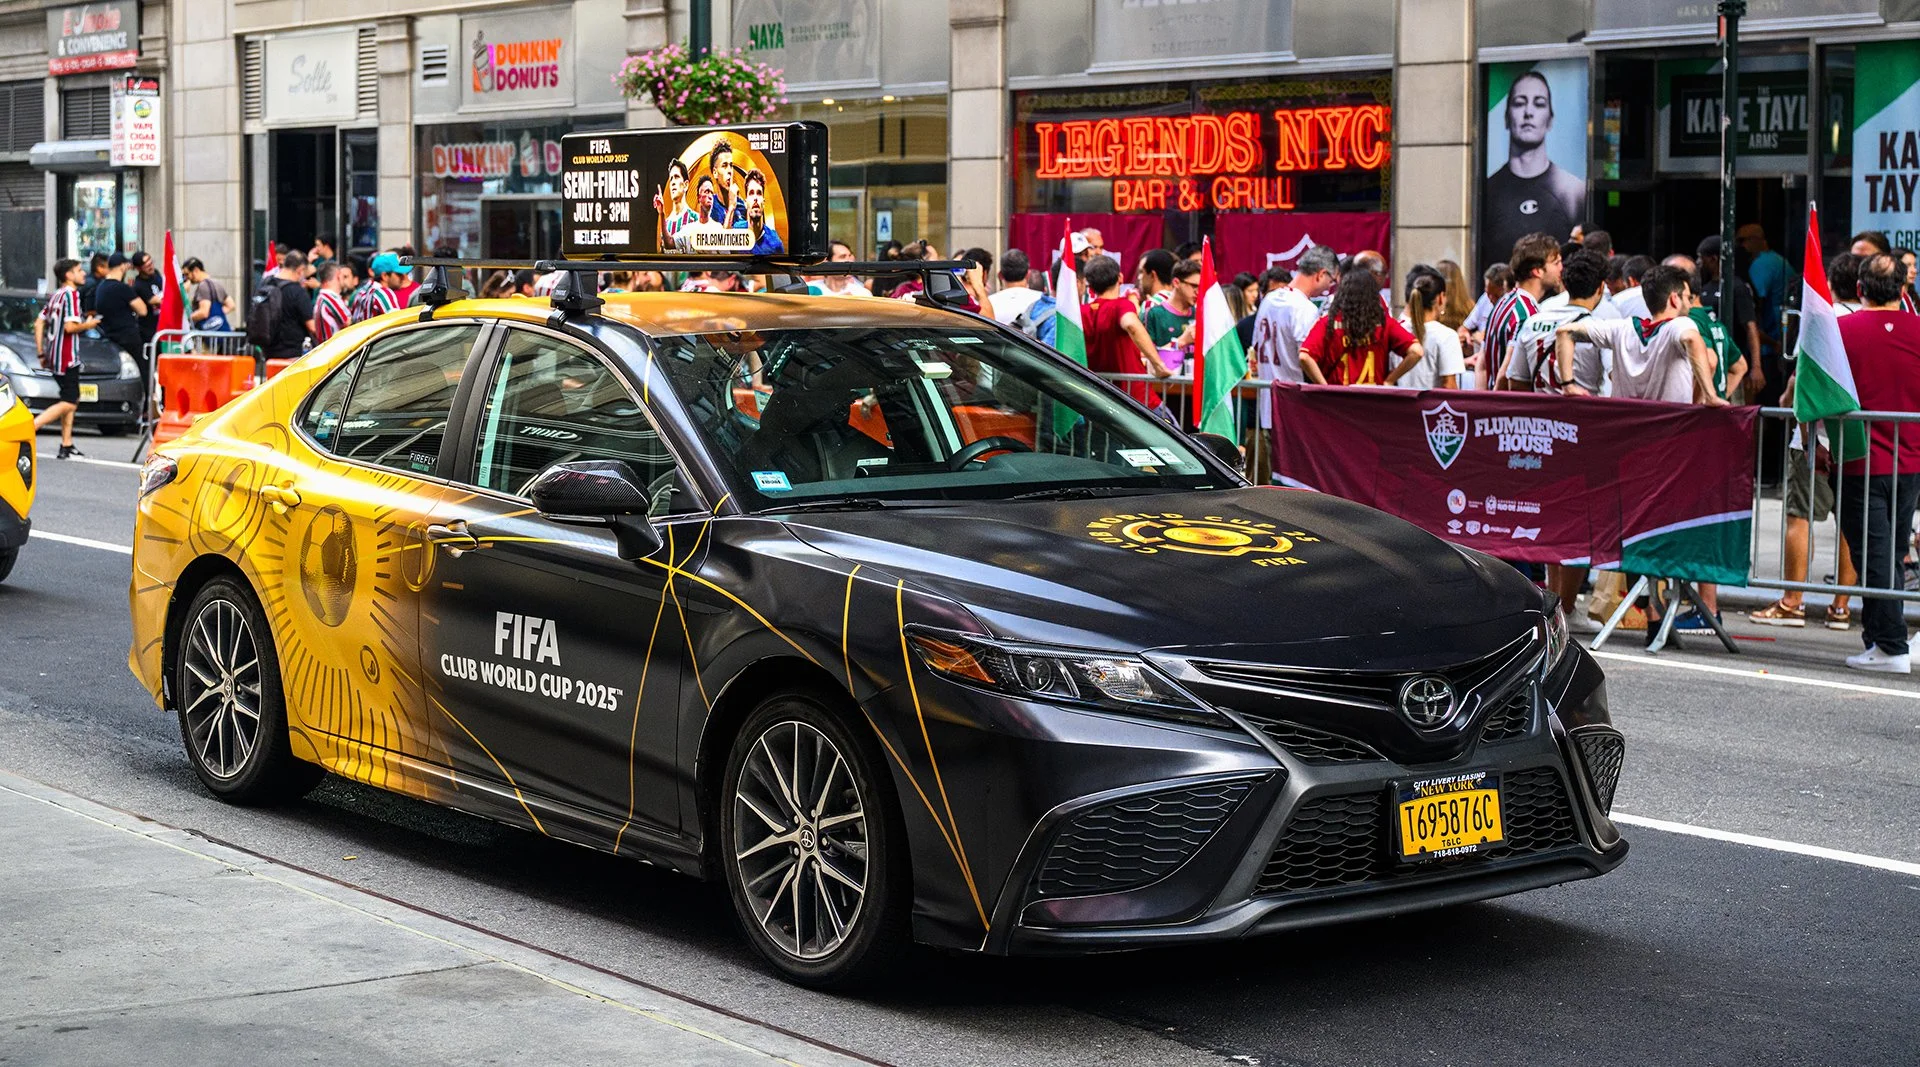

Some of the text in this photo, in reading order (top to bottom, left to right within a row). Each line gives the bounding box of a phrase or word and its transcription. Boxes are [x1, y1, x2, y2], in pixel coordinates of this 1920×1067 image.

[67, 31, 128, 56] CONVENIENCE
[749, 22, 785, 51] NAYA
[496, 38, 562, 66] DUNKIN'
[496, 64, 558, 92] DONUTS
[589, 139, 612, 155] FIFA
[1035, 104, 1386, 179] LEGENDS NYC
[1749, 132, 1779, 149] ARMS
[1878, 131, 1920, 171] KA
[432, 140, 516, 178] DUNKIN'
[572, 155, 586, 165] CLUB
[586, 154, 604, 164] WORLD
[604, 154, 615, 163] CUP
[563, 169, 640, 200] SEMI-FINALS
[811, 154, 819, 232] FIREFLY
[1113, 176, 1294, 212] BAR & GRILL
[573, 202, 594, 223] JULY
[595, 202, 602, 223] 8
[609, 201, 630, 223] 3PM
[696, 233, 750, 246] FIFA.COM/TICKETS
[1340, 350, 1376, 386] 14
[1473, 417, 1579, 444] FLUMINENSE
[1497, 434, 1554, 456] HOUSE
[410, 452, 437, 466] FIREFLY
[1086, 512, 1184, 529] WORLD
[1204, 515, 1277, 529] CUP
[1251, 556, 1308, 567] FIFA
[494, 611, 561, 667] FIFA
[440, 653, 478, 681] CLUB
[479, 661, 537, 693] WORLD
[539, 673, 573, 700] CUP
[1413, 771, 1486, 789] CITY LIVERY LEASING
[1420, 779, 1475, 798] NEW YORK
[1405, 794, 1494, 843] T695876C
[1433, 845, 1478, 858] 718-618-0972
[1441, 837, 1462, 847] T&LC
